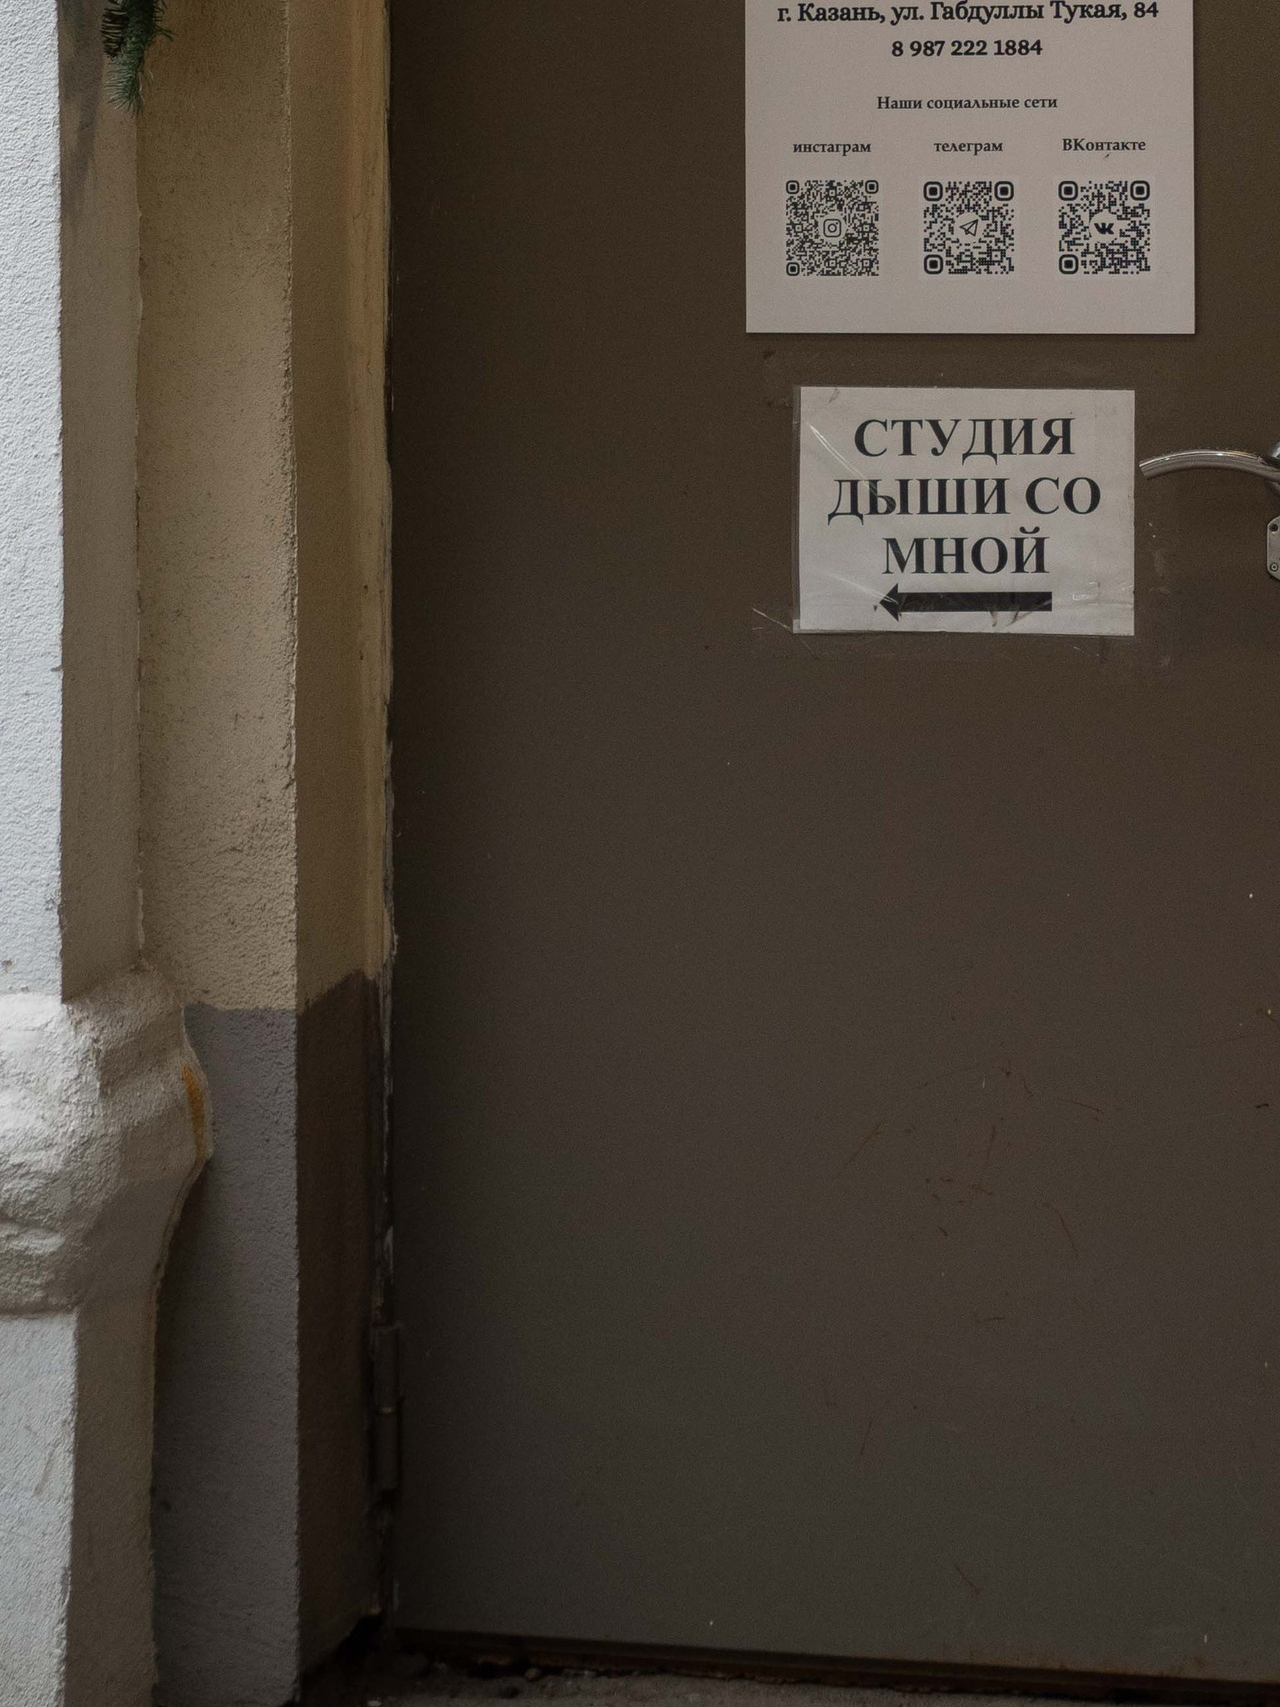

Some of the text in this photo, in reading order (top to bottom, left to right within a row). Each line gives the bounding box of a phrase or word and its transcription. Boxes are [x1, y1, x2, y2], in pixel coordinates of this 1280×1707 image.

[777, 0, 1158, 26] г. Казань, ул. Габдуллы Тукая, 84
[891, 39, 1043, 57] 8 987 222 1884
[877, 95, 1058, 111] Наши социальные сети
[793, 140, 872, 157] инстаграм
[934, 139, 1003, 156] телеграм
[1062, 137, 1146, 152] ВКонтакте
[854, 417, 1075, 465] СТУДИЯ
[828, 476, 1101, 526] ДЫШИ СО
[882, 526, 1050, 575] МНОЙ
